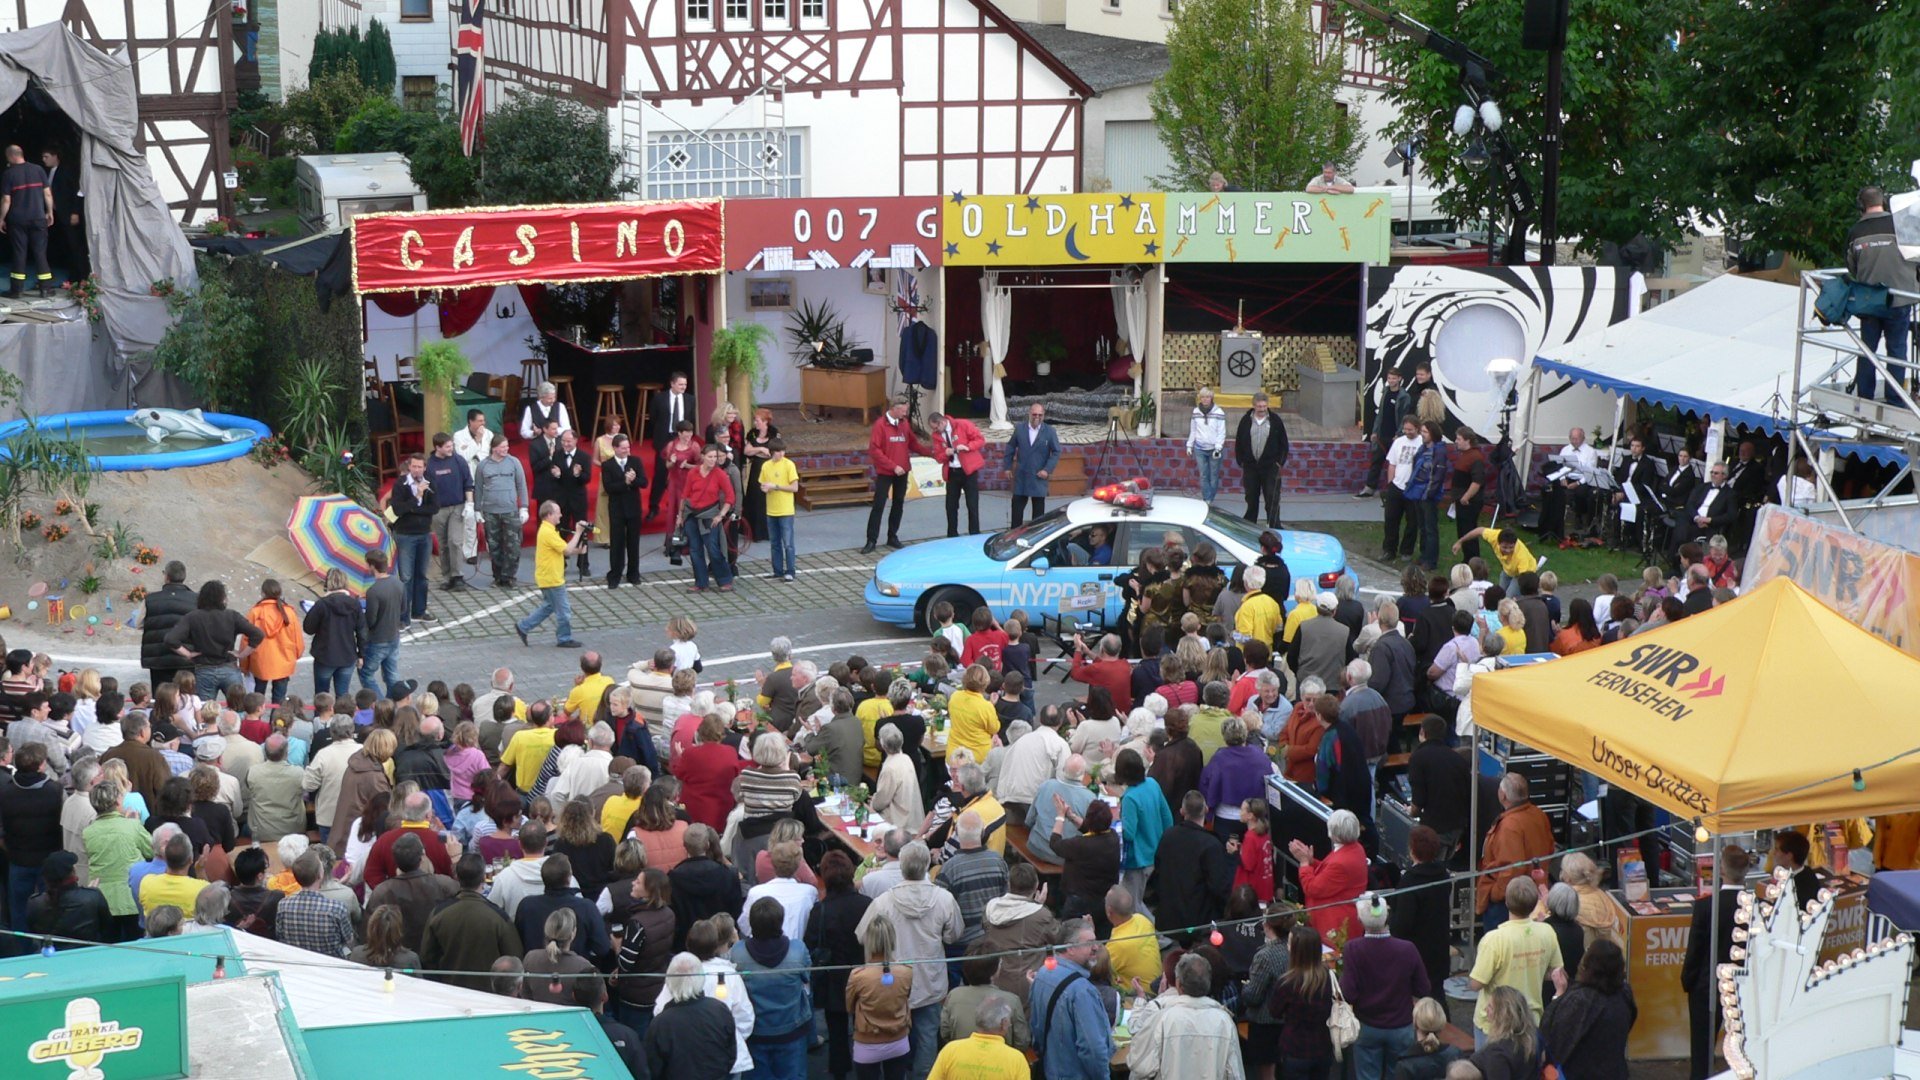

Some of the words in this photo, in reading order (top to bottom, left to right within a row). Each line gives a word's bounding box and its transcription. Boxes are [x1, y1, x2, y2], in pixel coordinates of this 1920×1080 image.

[793, 207, 878, 242] 007
[915, 199, 1313, 239] GOLDHAMMER
[400, 218, 685, 273] CASINO
[1009, 581, 1080, 606] NYPD
[1613, 643, 1700, 688] SWR
[1586, 669, 1694, 722] FERNSEHEN
[1591, 735, 1643, 781] Unser
[1644, 764, 1713, 815] Drittes
[34, 1031, 139, 1059] GILBERG
[499, 1027, 600, 1080] cher
